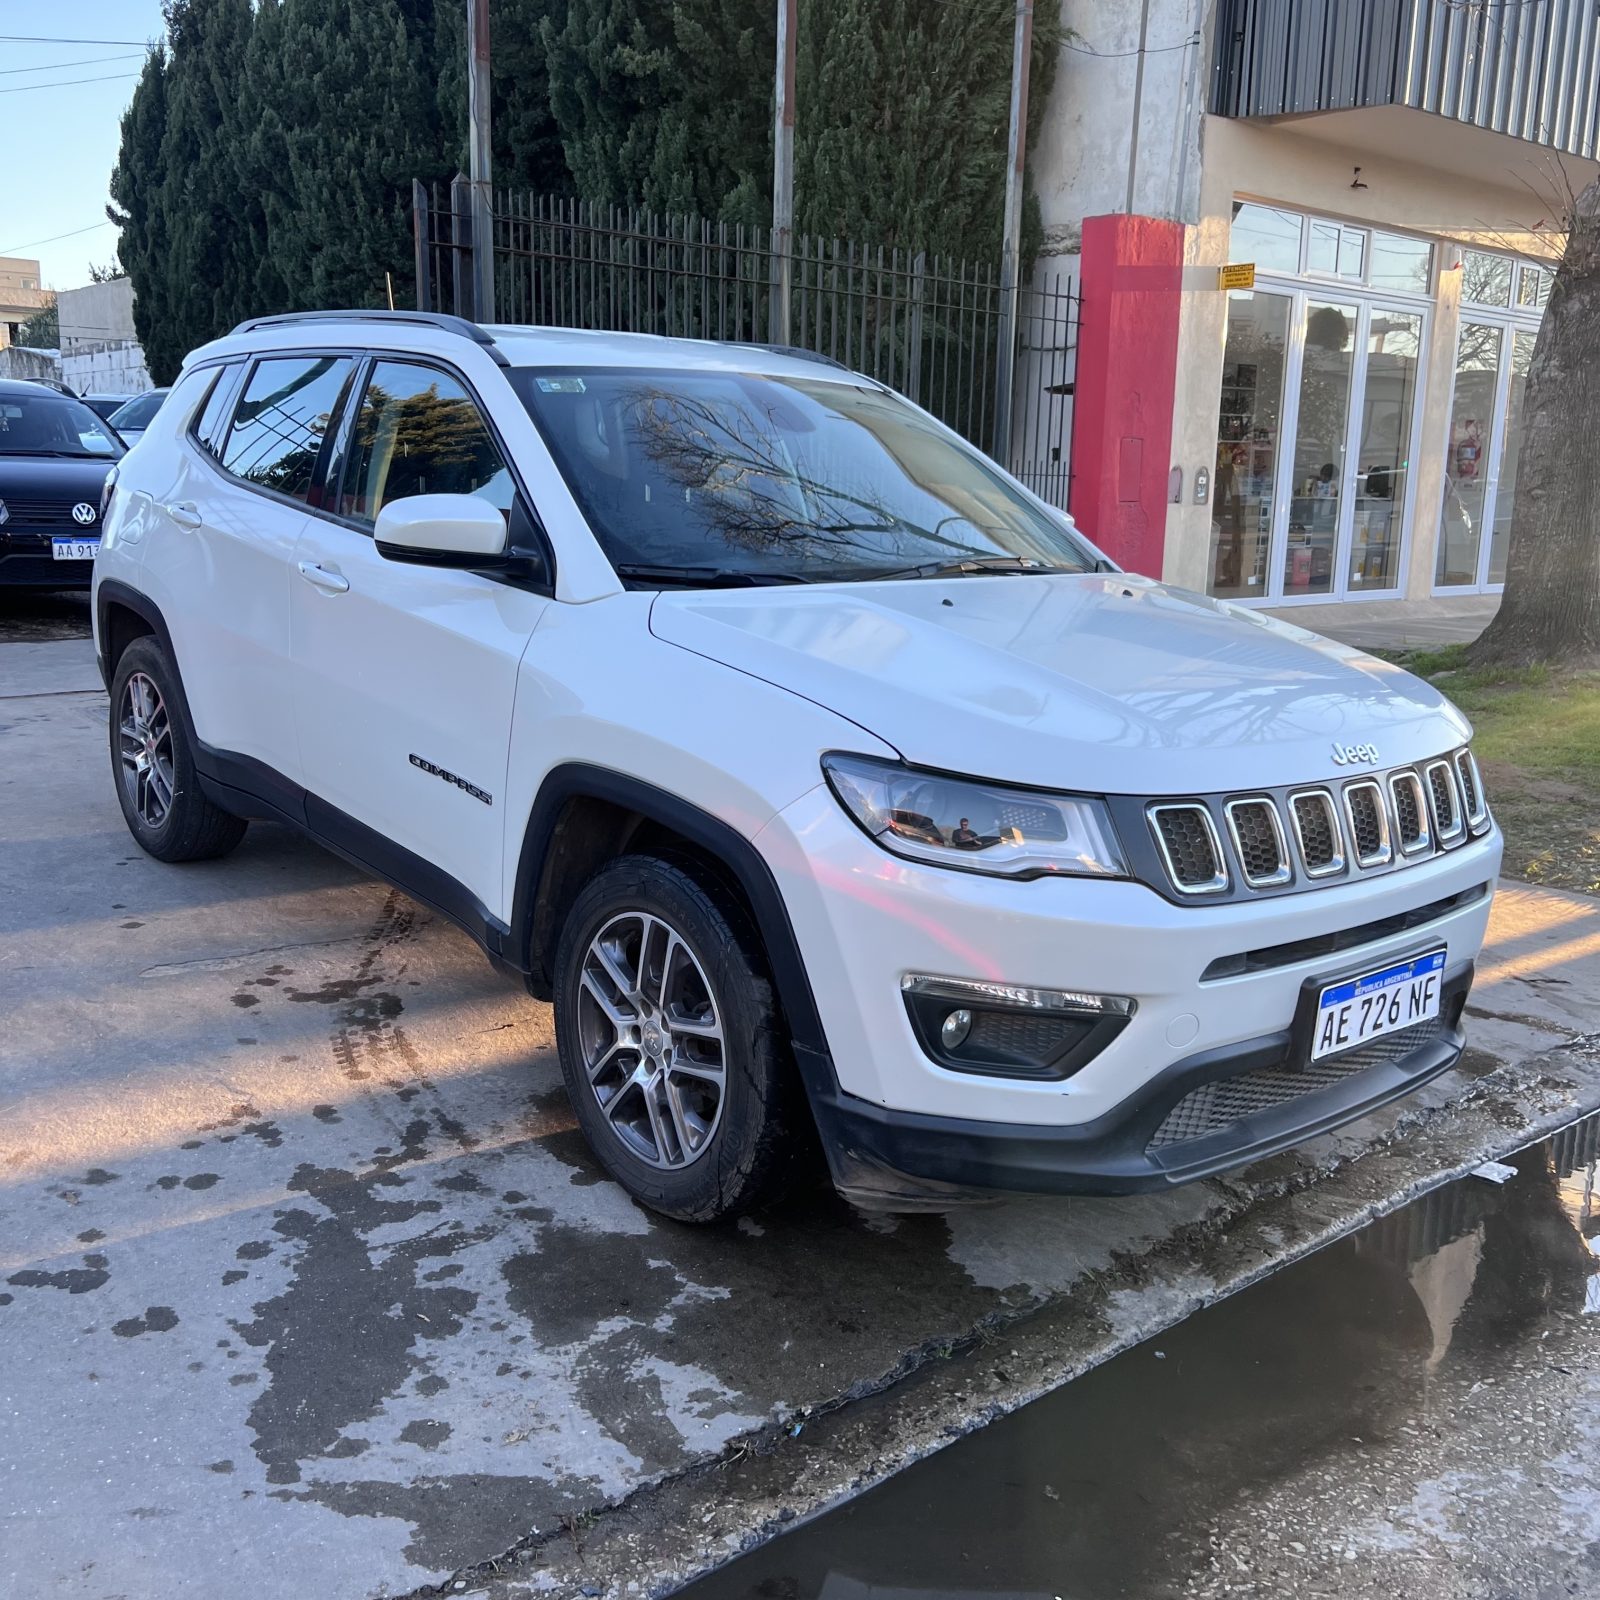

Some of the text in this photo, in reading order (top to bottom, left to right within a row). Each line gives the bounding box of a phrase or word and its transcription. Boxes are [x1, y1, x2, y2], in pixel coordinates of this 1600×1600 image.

[58, 545, 73, 557] AA
[1331, 742, 1379, 766] Jeep
[409, 753, 493, 806] COMPASS
[1384, 971, 1413, 986] ARGENTINA
[1320, 975, 1437, 1051] AE 726 NF
